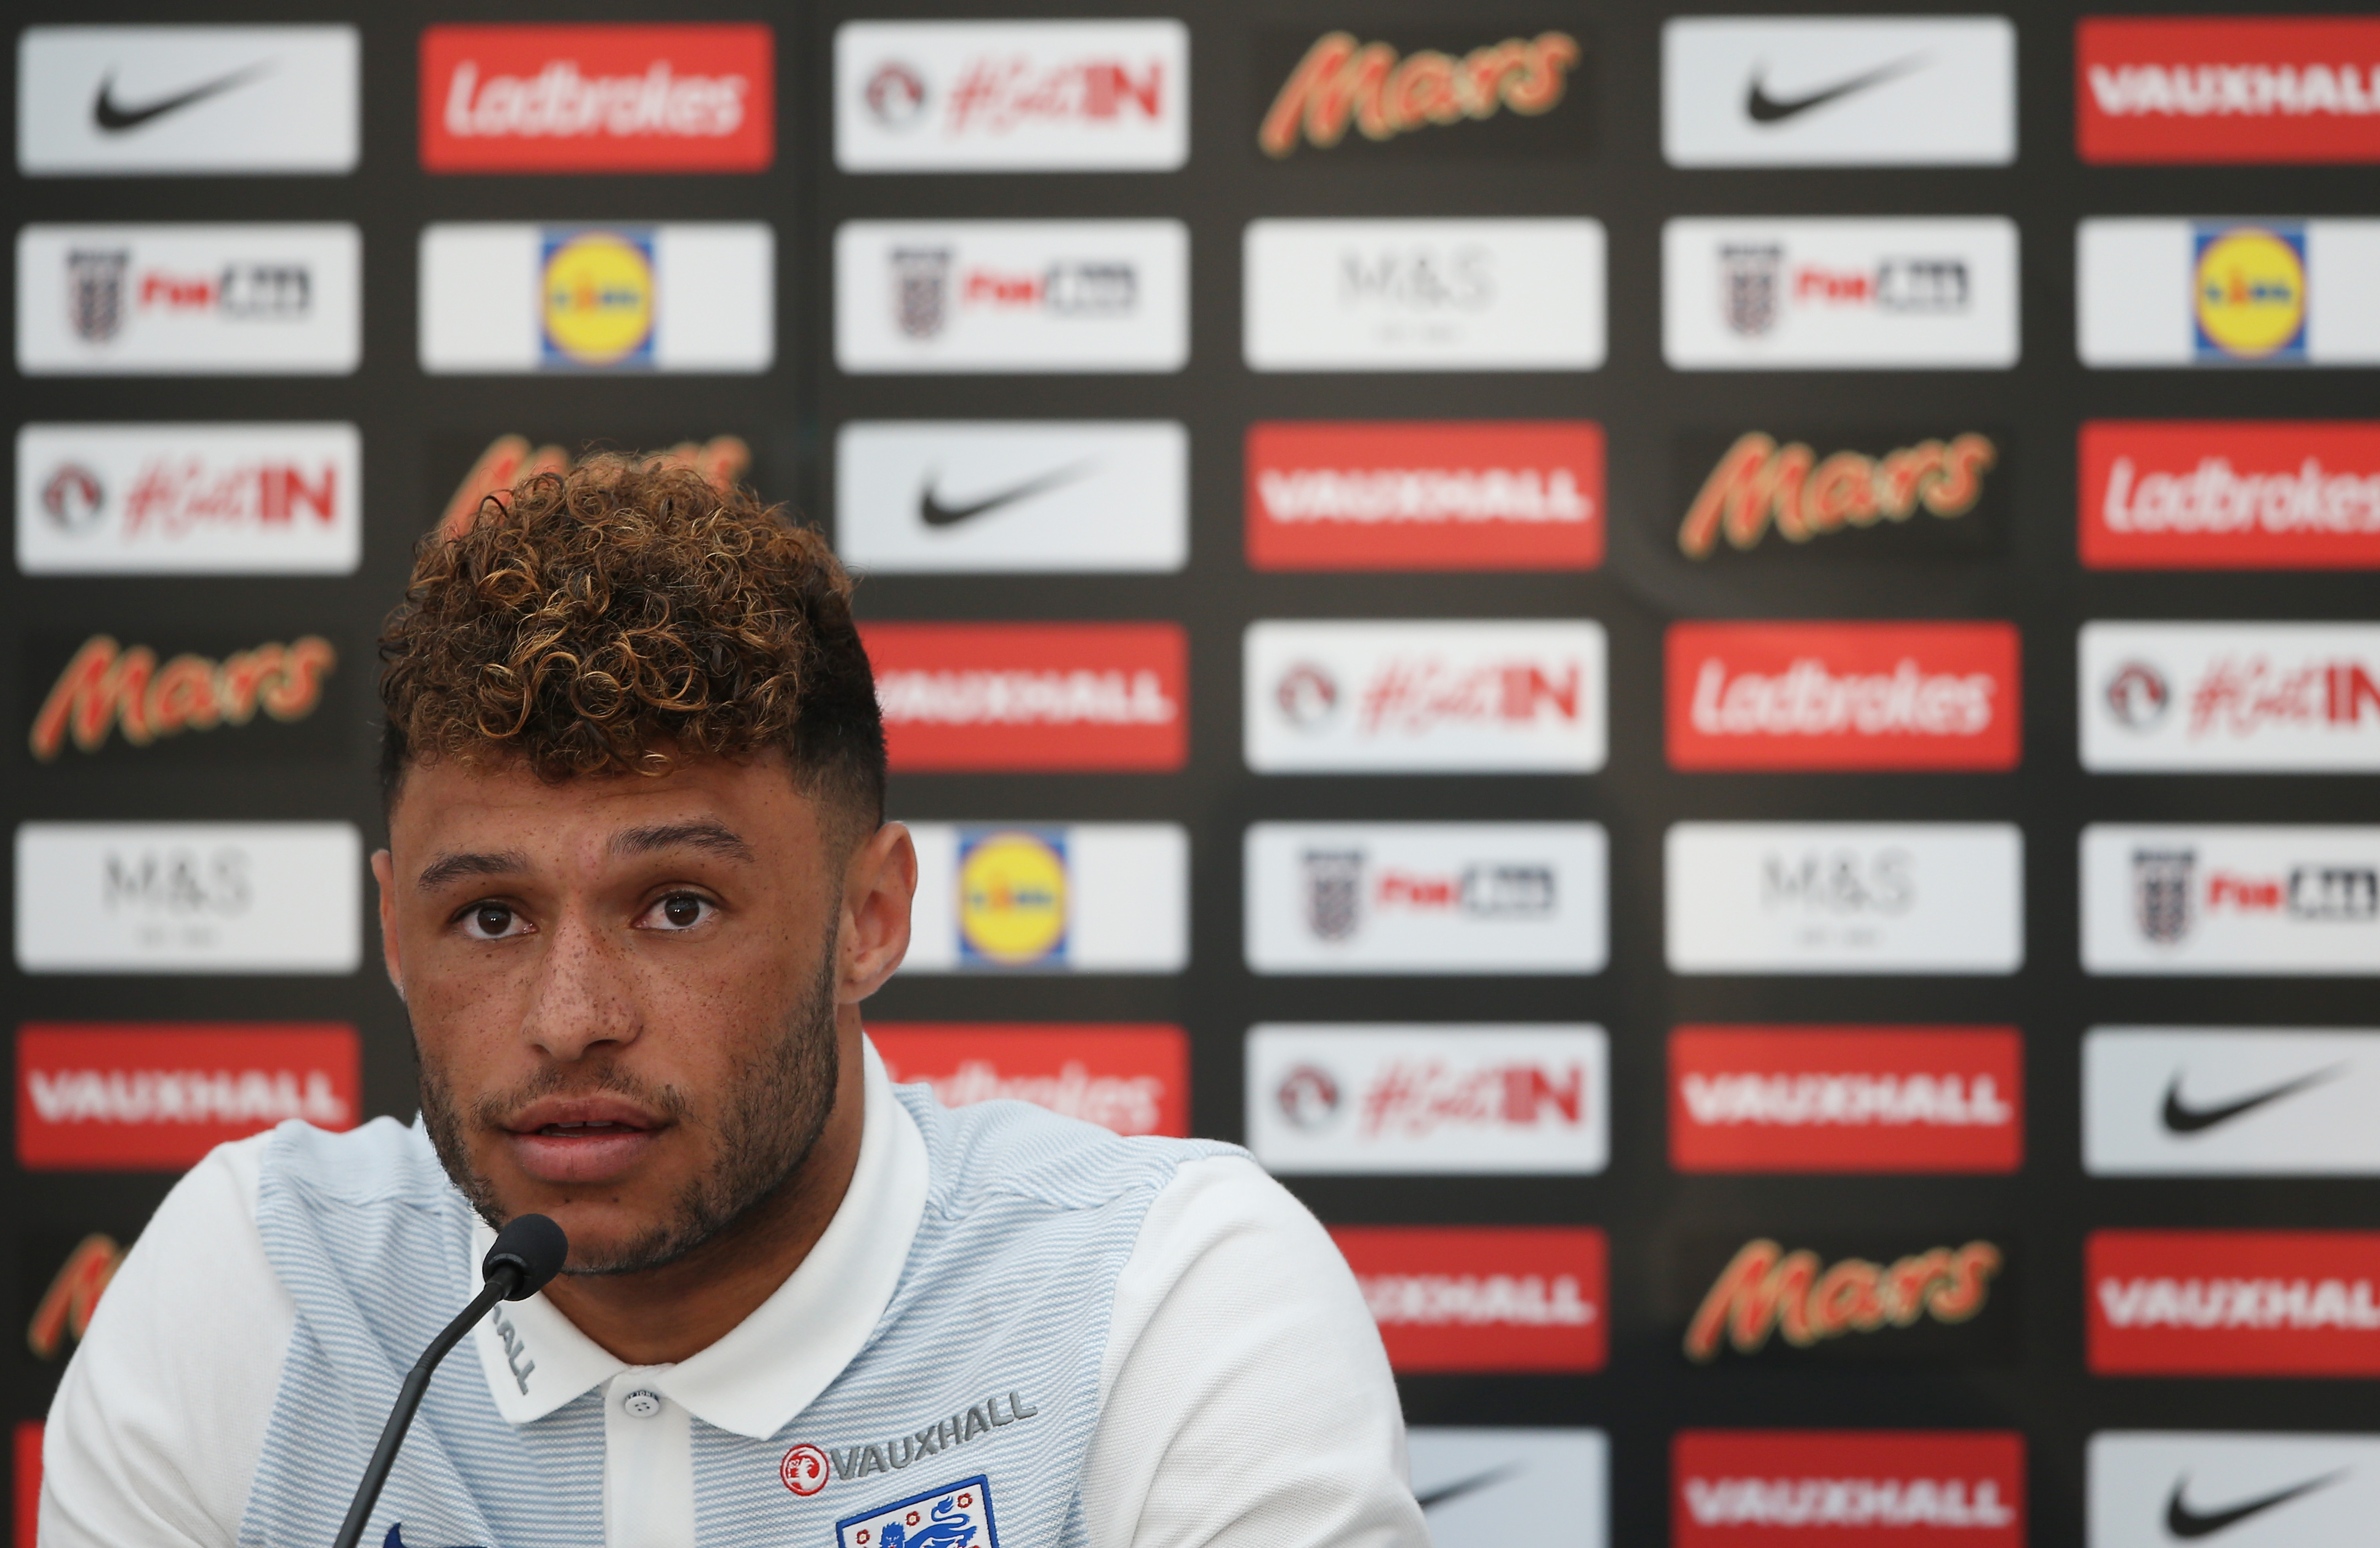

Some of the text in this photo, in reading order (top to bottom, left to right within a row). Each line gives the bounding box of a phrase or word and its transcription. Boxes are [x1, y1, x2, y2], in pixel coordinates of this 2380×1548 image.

[443, 61, 747, 137] Ladbrokes
[1258, 31, 1578, 157] Mars
[1338, 243, 1497, 310] M&S
[1258, 468, 1592, 524] VAUXHALL
[1677, 431, 1994, 559] Mars
[30, 635, 336, 762] Mars
[1690, 658, 1993, 735] Ladbrokes
[101, 849, 253, 914] M&S
[1760, 848, 1916, 916] M&S
[28, 1069, 347, 1126] VAUXHALL
[1680, 1072, 2011, 1126] VAUXHALL
[1356, 1274, 1595, 1326] UXHALL
[1685, 1238, 2001, 1362] Mars
[2098, 1278, 2380, 1329] VAUXHAL
[829, 1391, 1038, 1481] VAUXHALL
[1683, 1477, 2013, 1529] VAUXHALL
